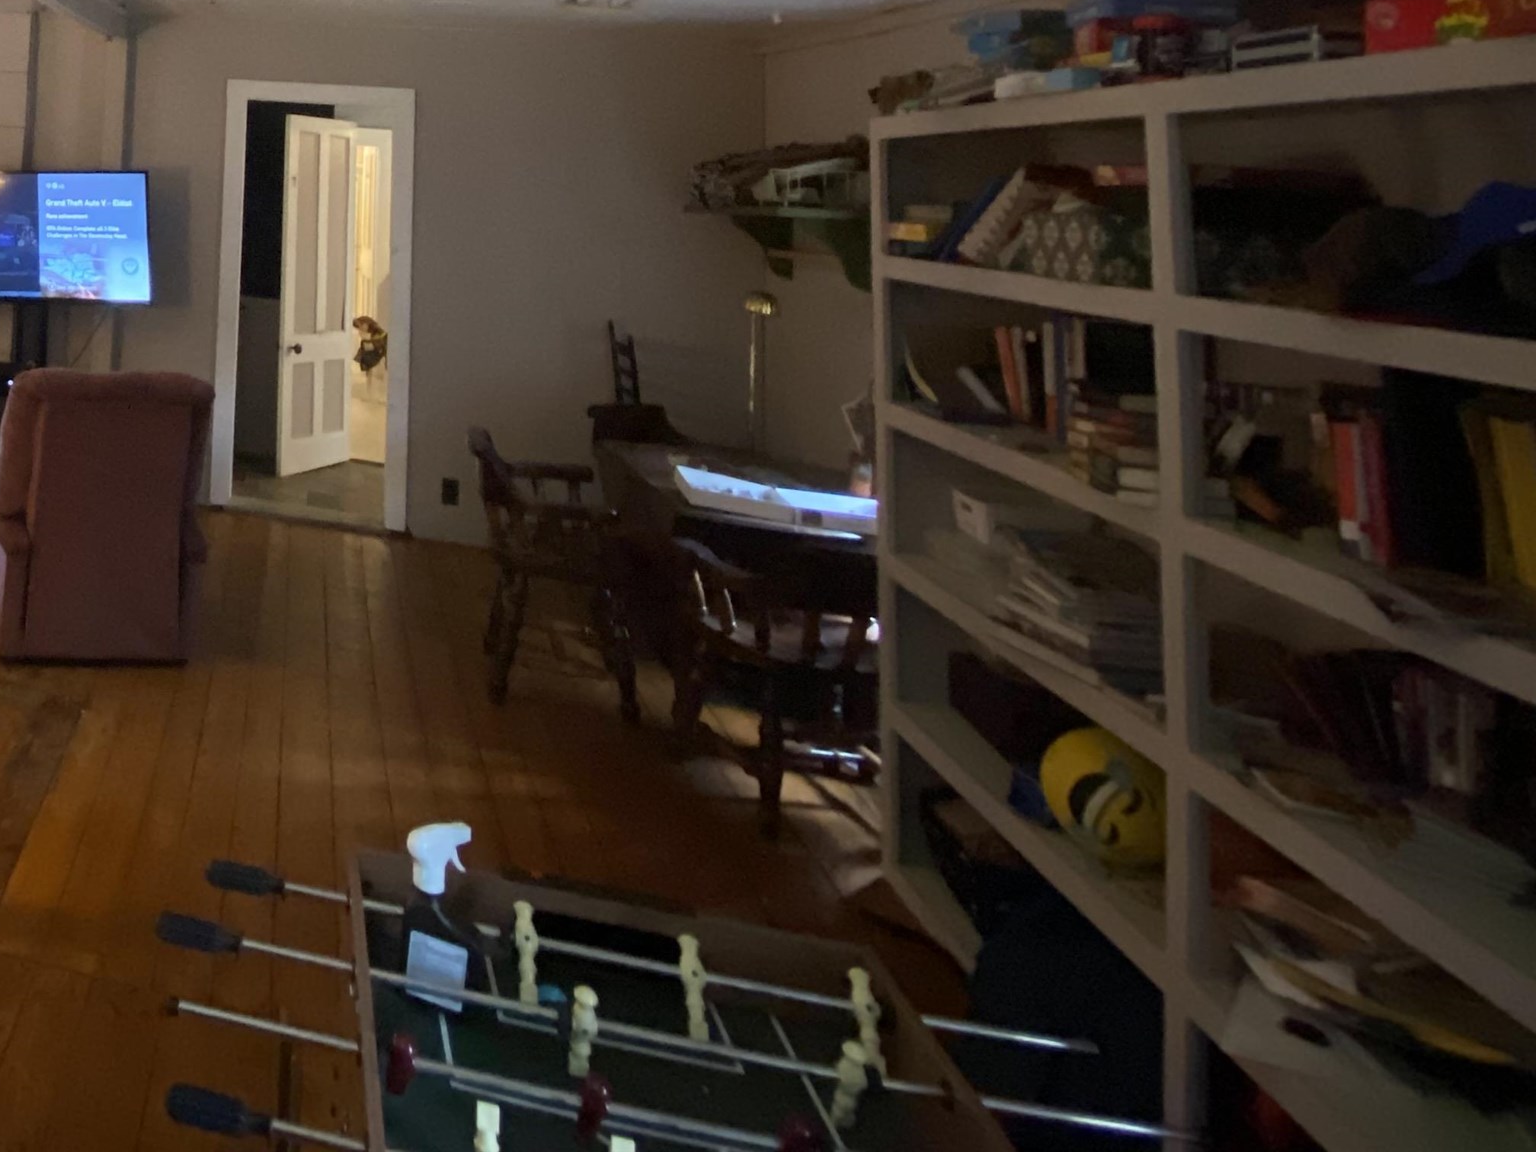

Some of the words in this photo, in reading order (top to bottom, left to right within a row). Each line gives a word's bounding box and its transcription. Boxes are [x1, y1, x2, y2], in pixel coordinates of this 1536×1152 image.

[45, 198, 66, 207] Grand
[67, 198, 83, 207] Theft
[84, 198, 100, 207] Auto
[101, 198, 107, 207] V
